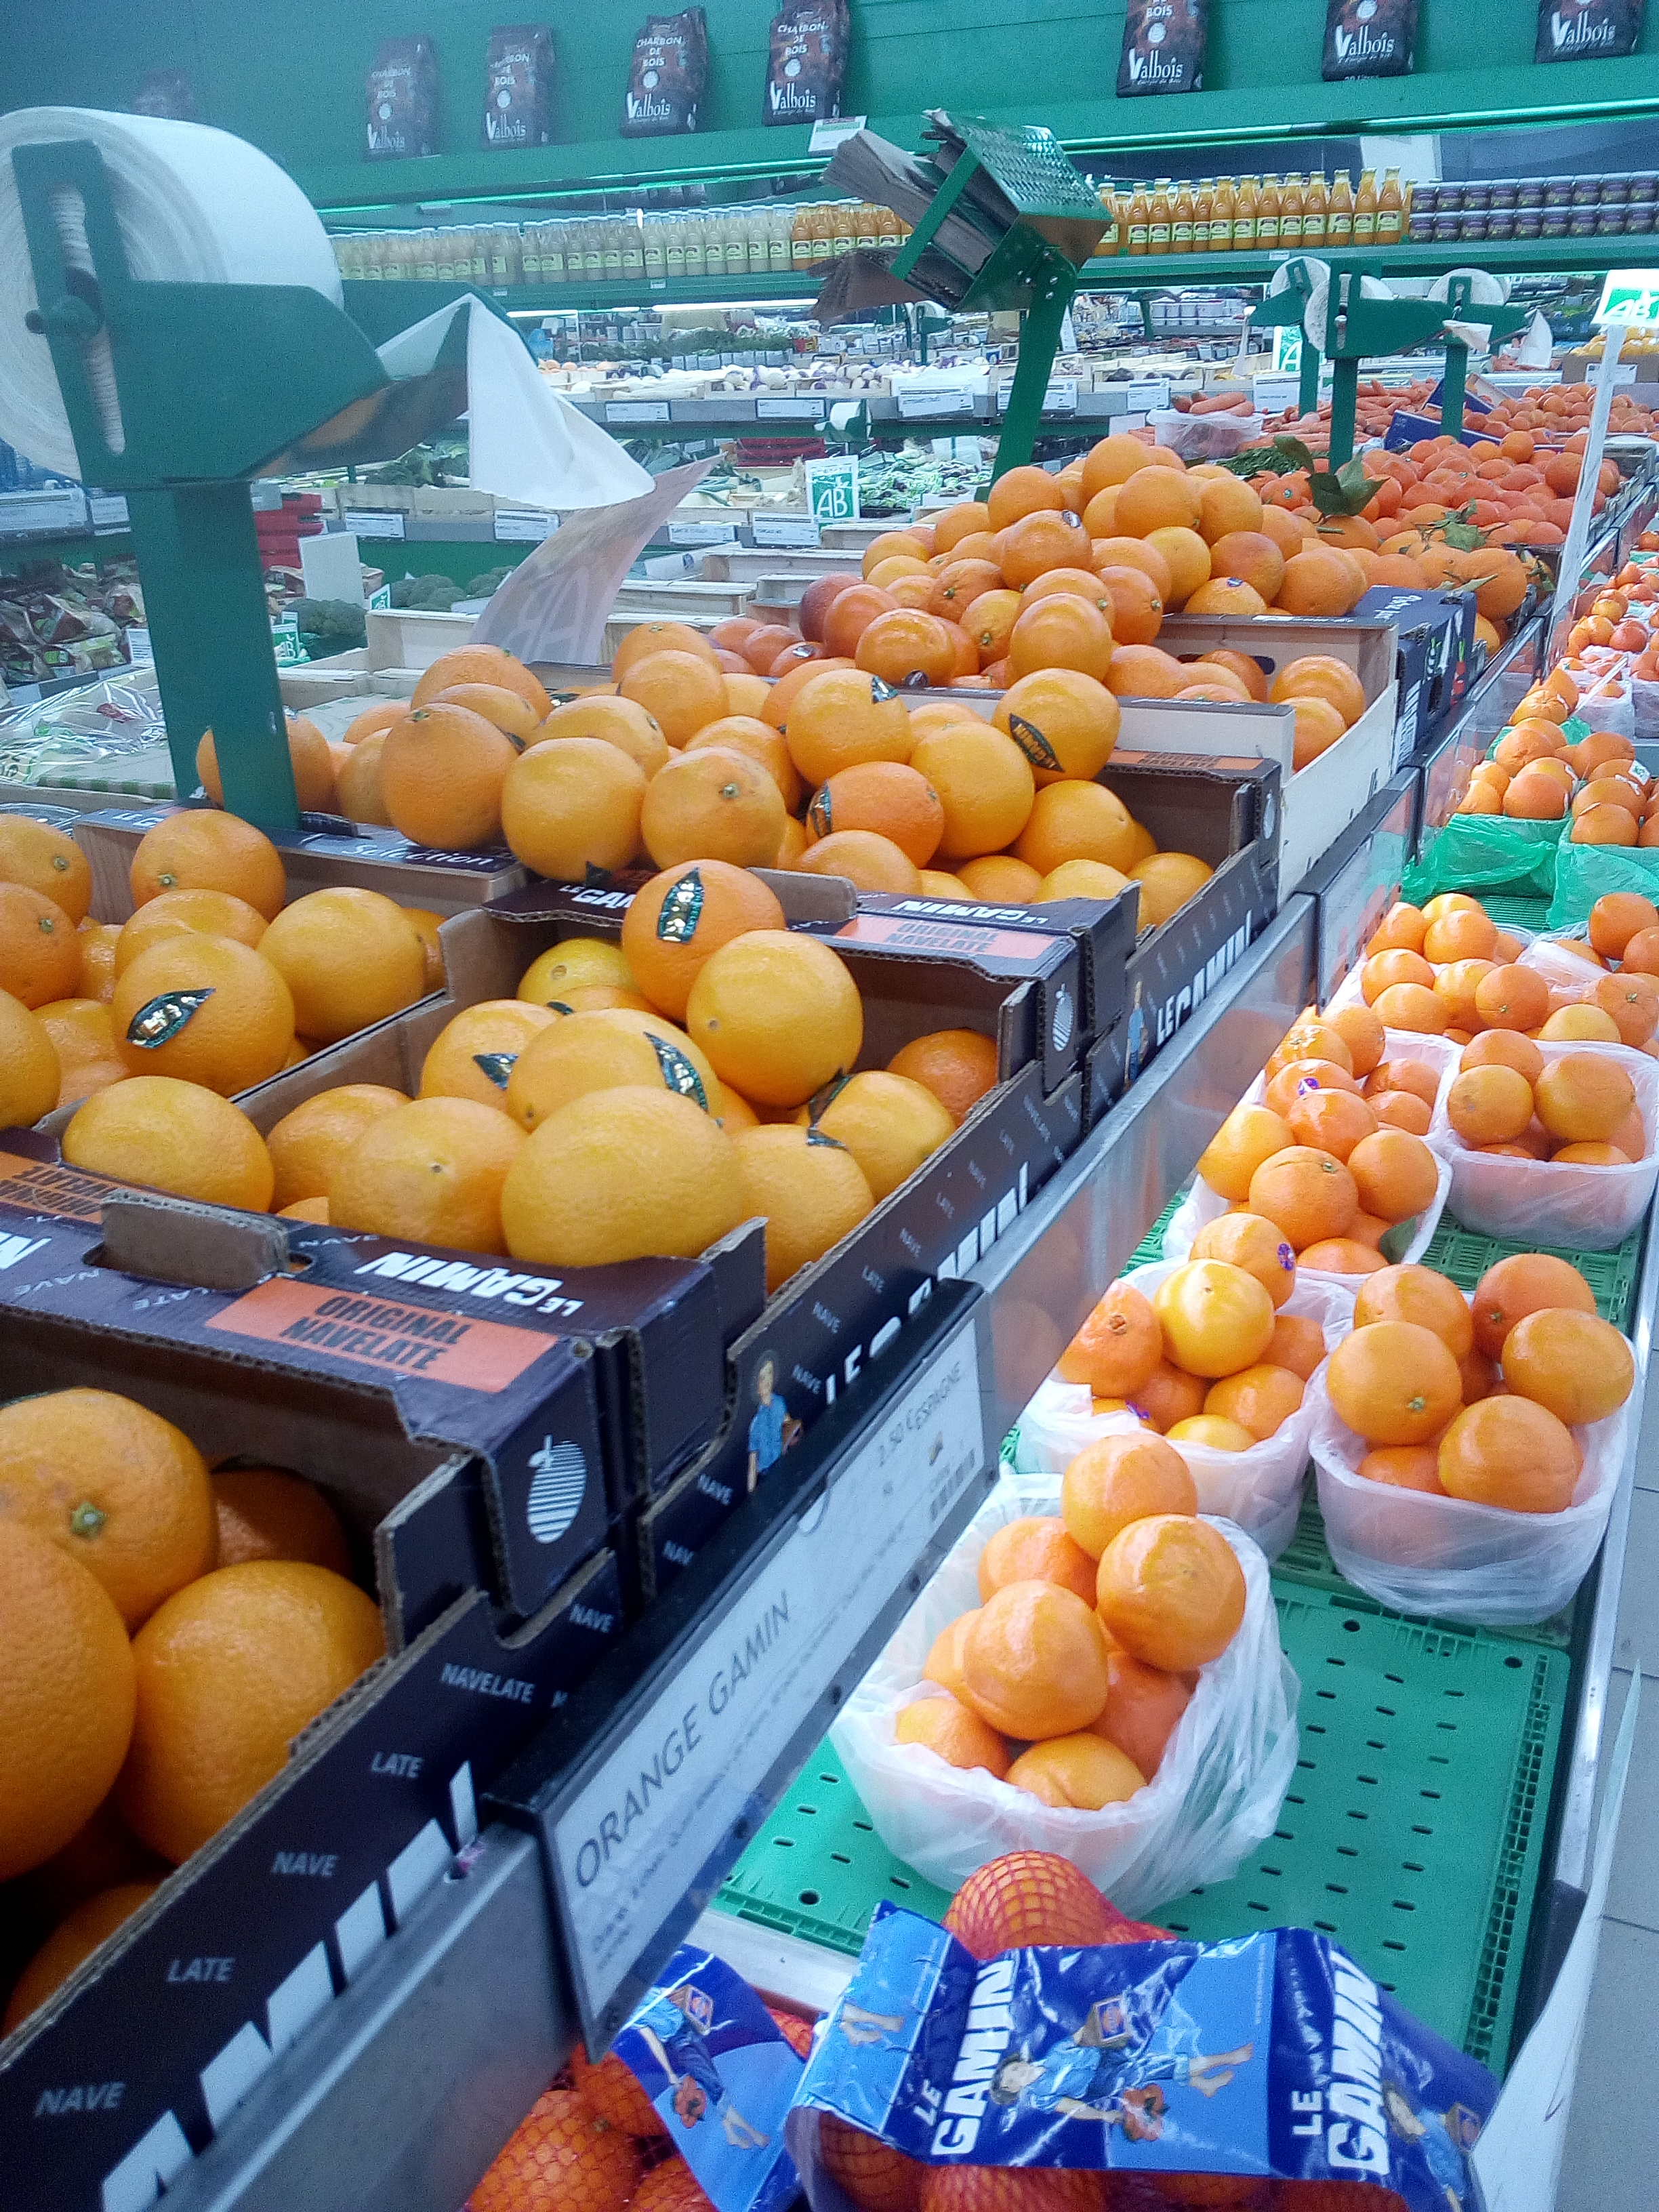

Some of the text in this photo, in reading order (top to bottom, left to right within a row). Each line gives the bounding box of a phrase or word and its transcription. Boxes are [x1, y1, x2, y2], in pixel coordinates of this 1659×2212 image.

[1147, 5, 1173, 17] BOIS
[1335, 24, 1395, 59] Valbois
[1551, 9, 1617, 46] Valbois
[785, 43, 808, 56] BOIS
[1128, 48, 1185, 80] Valbois
[626, 90, 672, 119] Valbois
[770, 81, 817, 110] Valbois
[485, 111, 527, 140] Valbois
[816, 486, 848, 518] AB
[890, 899, 1030, 921] GAMIN
[14, 1267, 102, 1296] NAVE
[353, 1251, 584, 1317] LE GAMIN
[314, 1295, 472, 1345] ORIGINAL
[279, 1316, 448, 1370] NAVELATE
[697, 1473, 735, 1506] NAVE
[661, 1539, 695, 1567] NAV
[569, 1602, 615, 1634] NAVE
[440, 1661, 537, 1706] NAVELATE
[575, 1702, 703, 1888] ORANGE
[707, 1589, 792, 1716] GAMIN
[369, 1750, 426, 1780] LATE
[270, 1850, 340, 1878] NAVE
[166, 1956, 236, 1984] LATE
[912, 2077, 944, 2127] LE
[930, 1957, 1015, 2156] GAMIN
[1290, 2089, 1322, 2136] LE
[1326, 1948, 1391, 2177] GAMIN
[34, 2081, 127, 2118] NAVE
